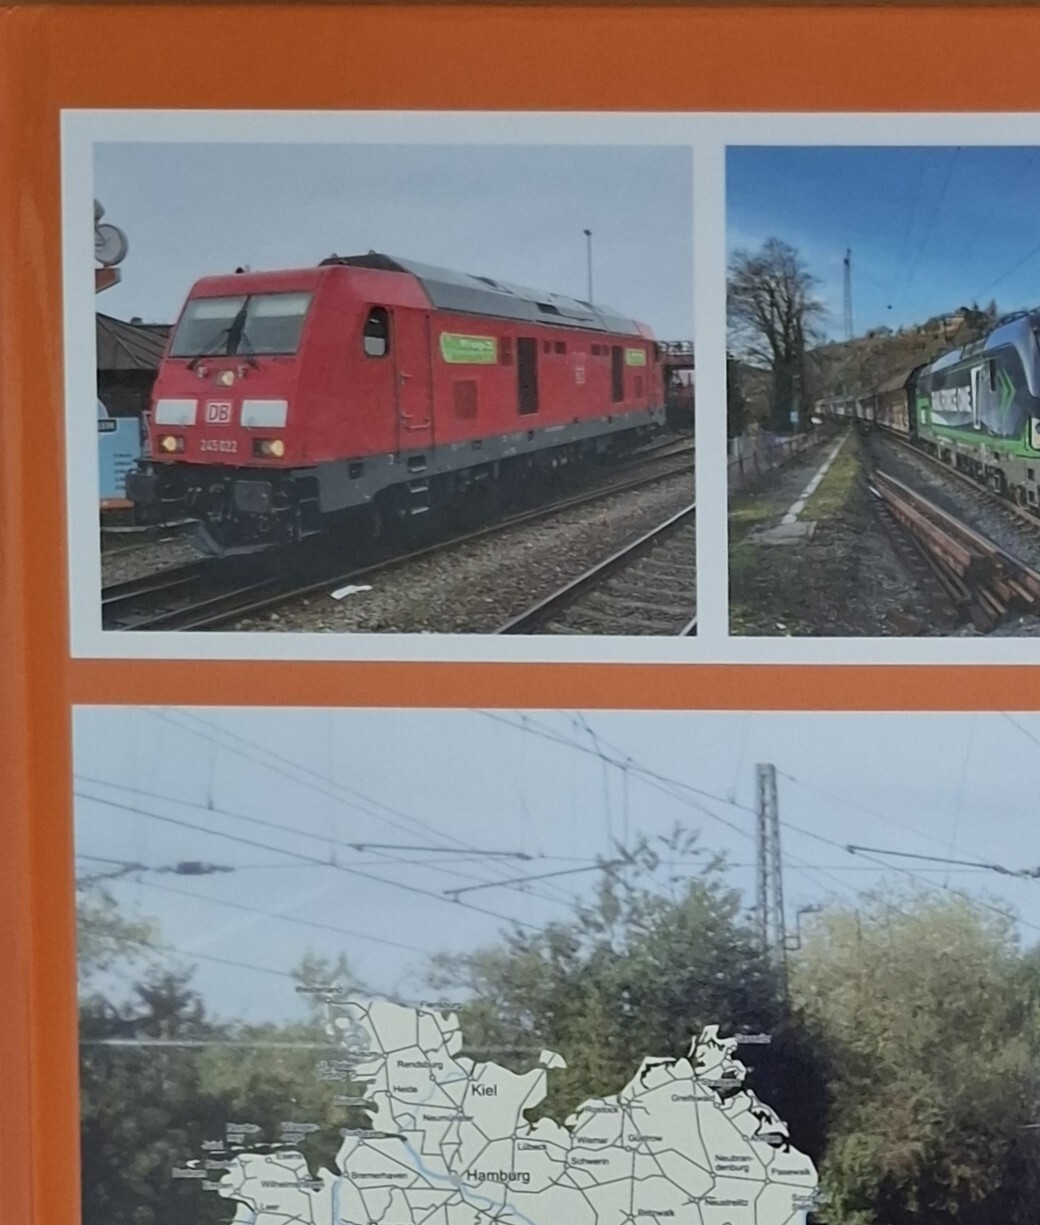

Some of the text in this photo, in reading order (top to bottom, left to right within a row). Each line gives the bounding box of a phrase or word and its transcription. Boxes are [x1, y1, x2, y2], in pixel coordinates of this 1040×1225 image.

[208, 404, 229, 421] DB
[397, 1060, 444, 1070] Rendsburg
[393, 1085, 418, 1093] Heide
[471, 1084, 497, 1096] Kiel
[577, 1136, 608, 1144] Wismar
[517, 1141, 547, 1151] Lübeck
[571, 1157, 609, 1165] Schwerin
[467, 1169, 531, 1184] Hamburg
